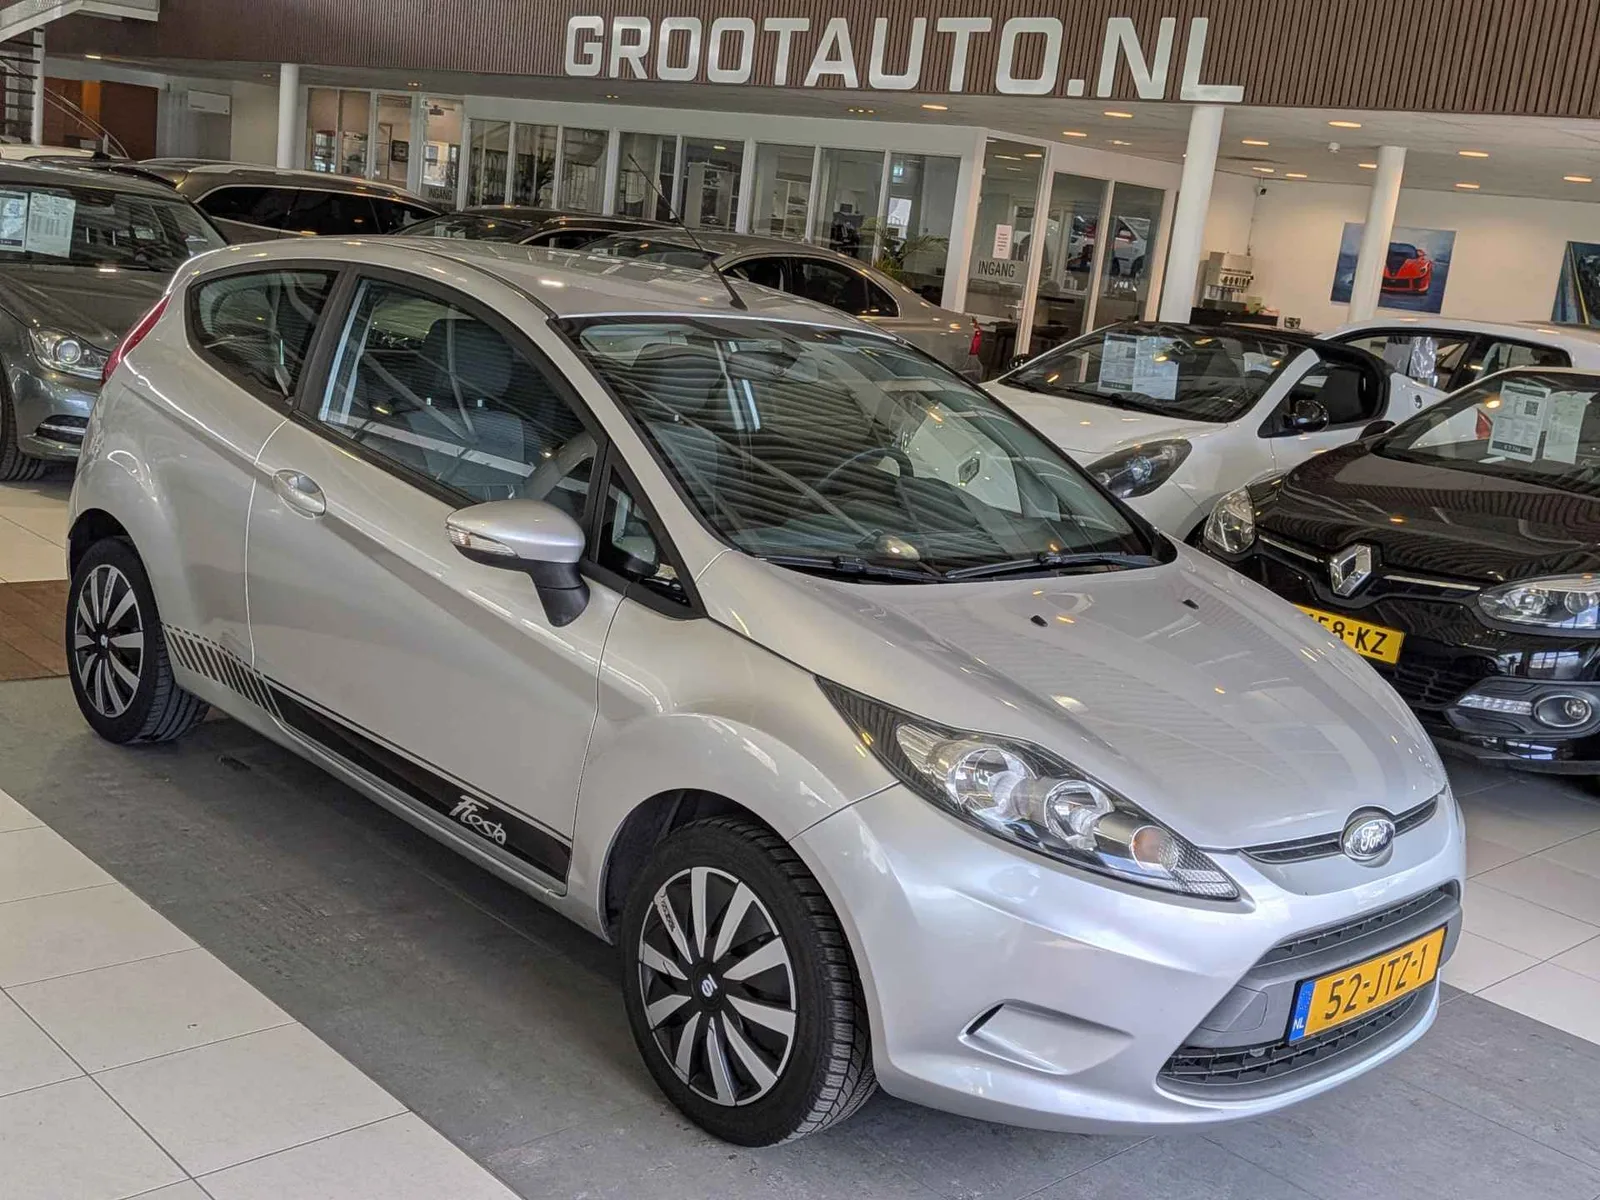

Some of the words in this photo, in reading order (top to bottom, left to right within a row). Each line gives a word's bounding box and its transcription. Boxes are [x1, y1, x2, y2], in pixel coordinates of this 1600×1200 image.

[565, 15, 1244, 102] GROOTAUTO.NL
[978, 260, 1015, 277] INGANG
[1360, 823, 1389, 851] Ford
[1325, 944, 1428, 1020] 52-JTZ-1
[1293, 1018, 1305, 1031] NL
